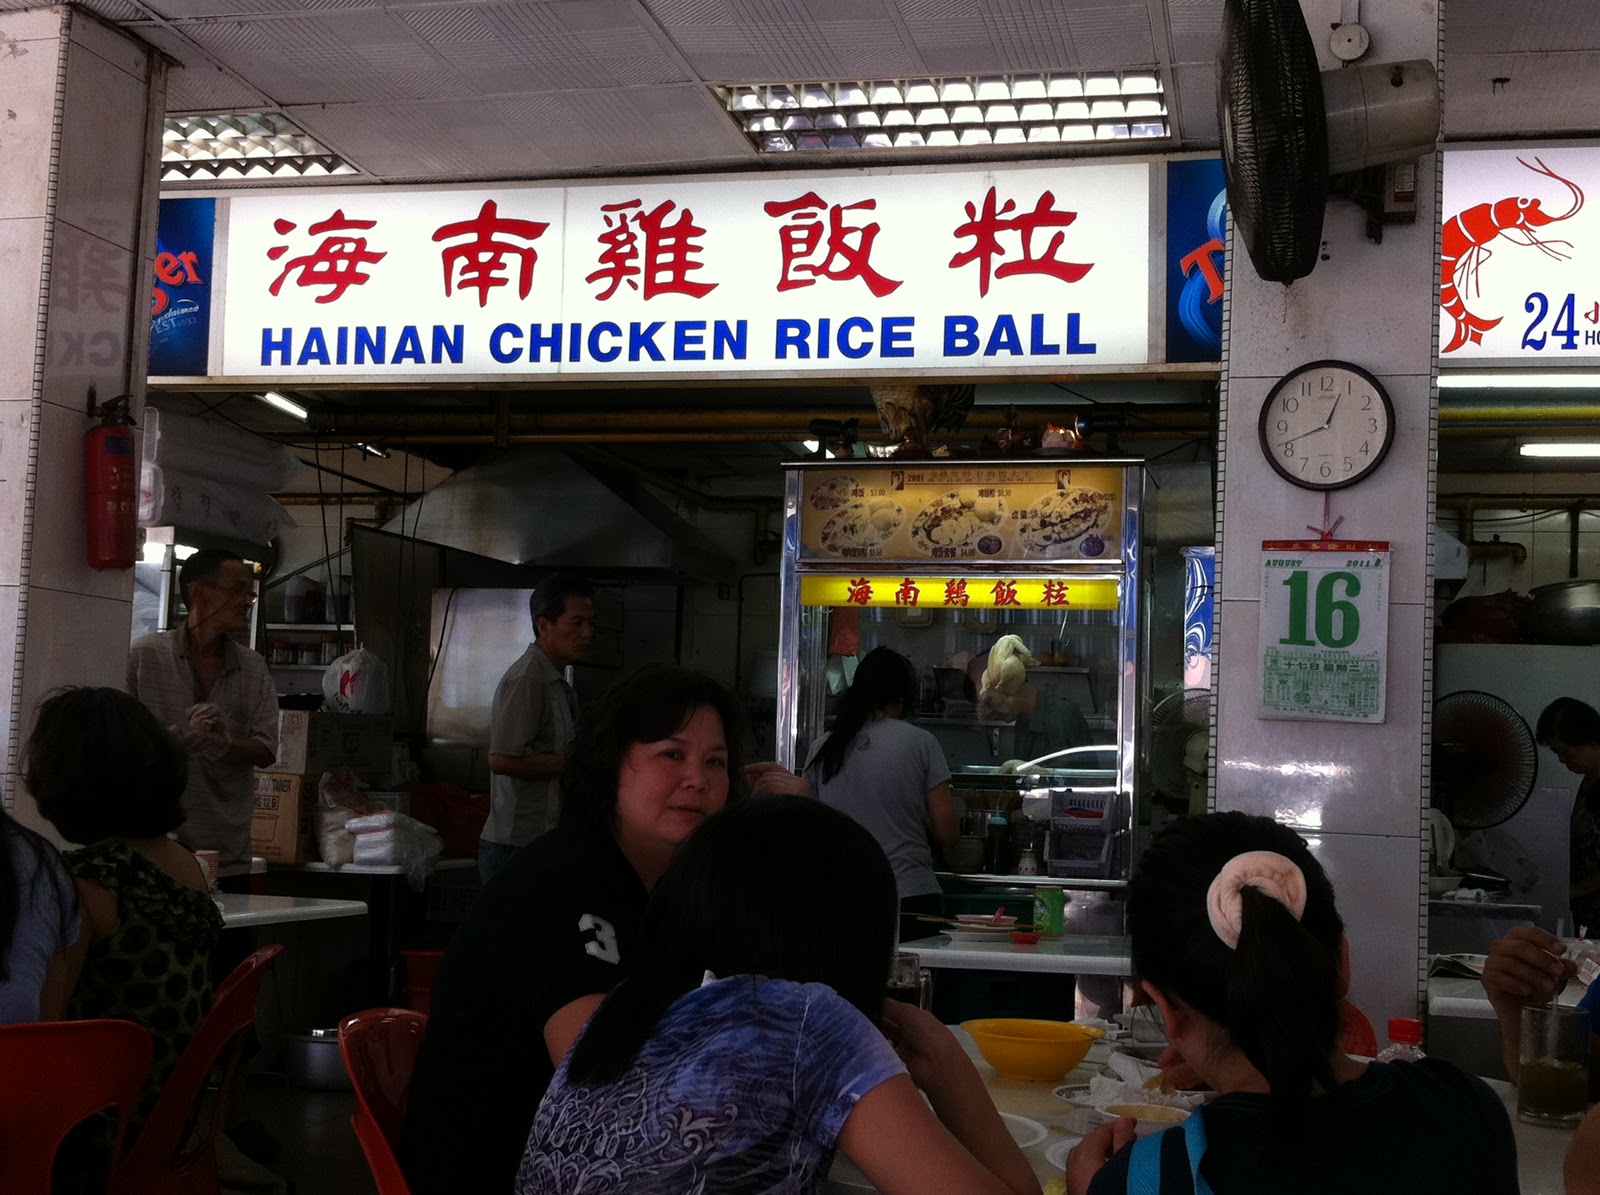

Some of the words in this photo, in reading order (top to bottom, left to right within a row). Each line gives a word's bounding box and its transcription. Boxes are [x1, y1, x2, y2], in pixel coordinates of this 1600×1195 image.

[1521, 292, 1580, 351] 24
[261, 324, 464, 366] HAINAN
[489, 319, 748, 363] CHICKEN
[776, 316, 915, 359] RICE
[943, 313, 1097, 357] BALL
[1321, 376, 1334, 391] 12
[1348, 380, 1351, 395] 1
[1282, 398, 1299, 413] 10
[1361, 395, 1371, 410] 2
[1277, 420, 1288, 435] 9
[1368, 418, 1378, 433] 3
[1284, 442, 1294, 457] 8
[1359, 440, 1369, 455] 4
[1300, 457, 1309, 472] 7
[1320, 461, 1331, 477] 6
[1344, 456, 1353, 472] 5
[1265, 559, 1302, 567] AUGUST
[1279, 570, 1361, 649] 16
